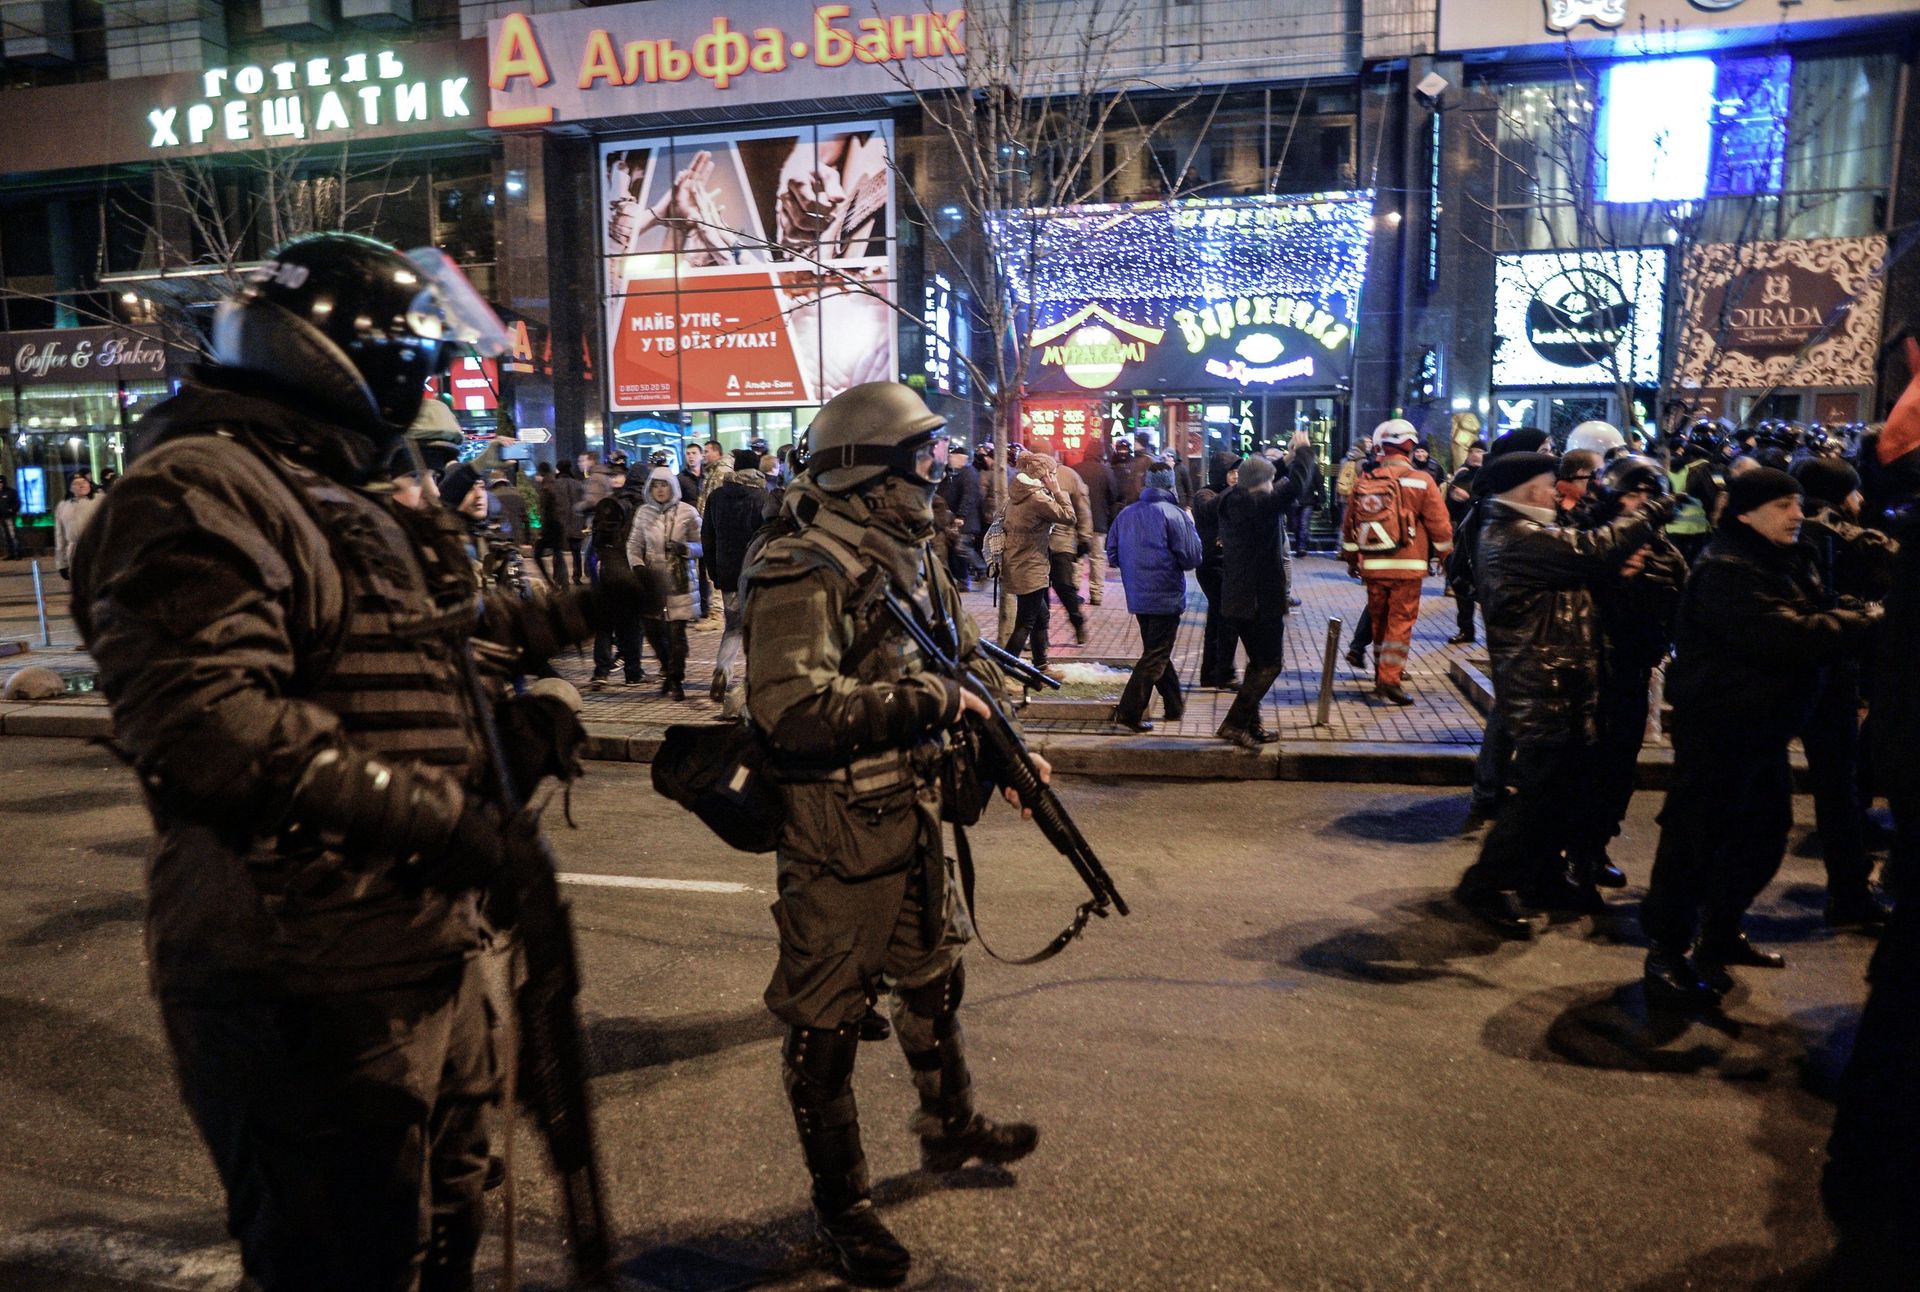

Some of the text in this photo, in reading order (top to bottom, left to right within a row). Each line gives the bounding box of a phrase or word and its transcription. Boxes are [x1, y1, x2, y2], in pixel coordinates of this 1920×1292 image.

[204, 50, 404, 98] ГОТЕЛЬ
[148, 76, 471, 148] ХРЕЩАТИК
[631, 312, 722, 331] МАЙБУТНЄ
[1729, 307, 1823, 327] OTRADA
[641, 331, 777, 352] У ТВОЇХ РУКАХ!
[15, 337, 167, 377] Coffee & Bakery
